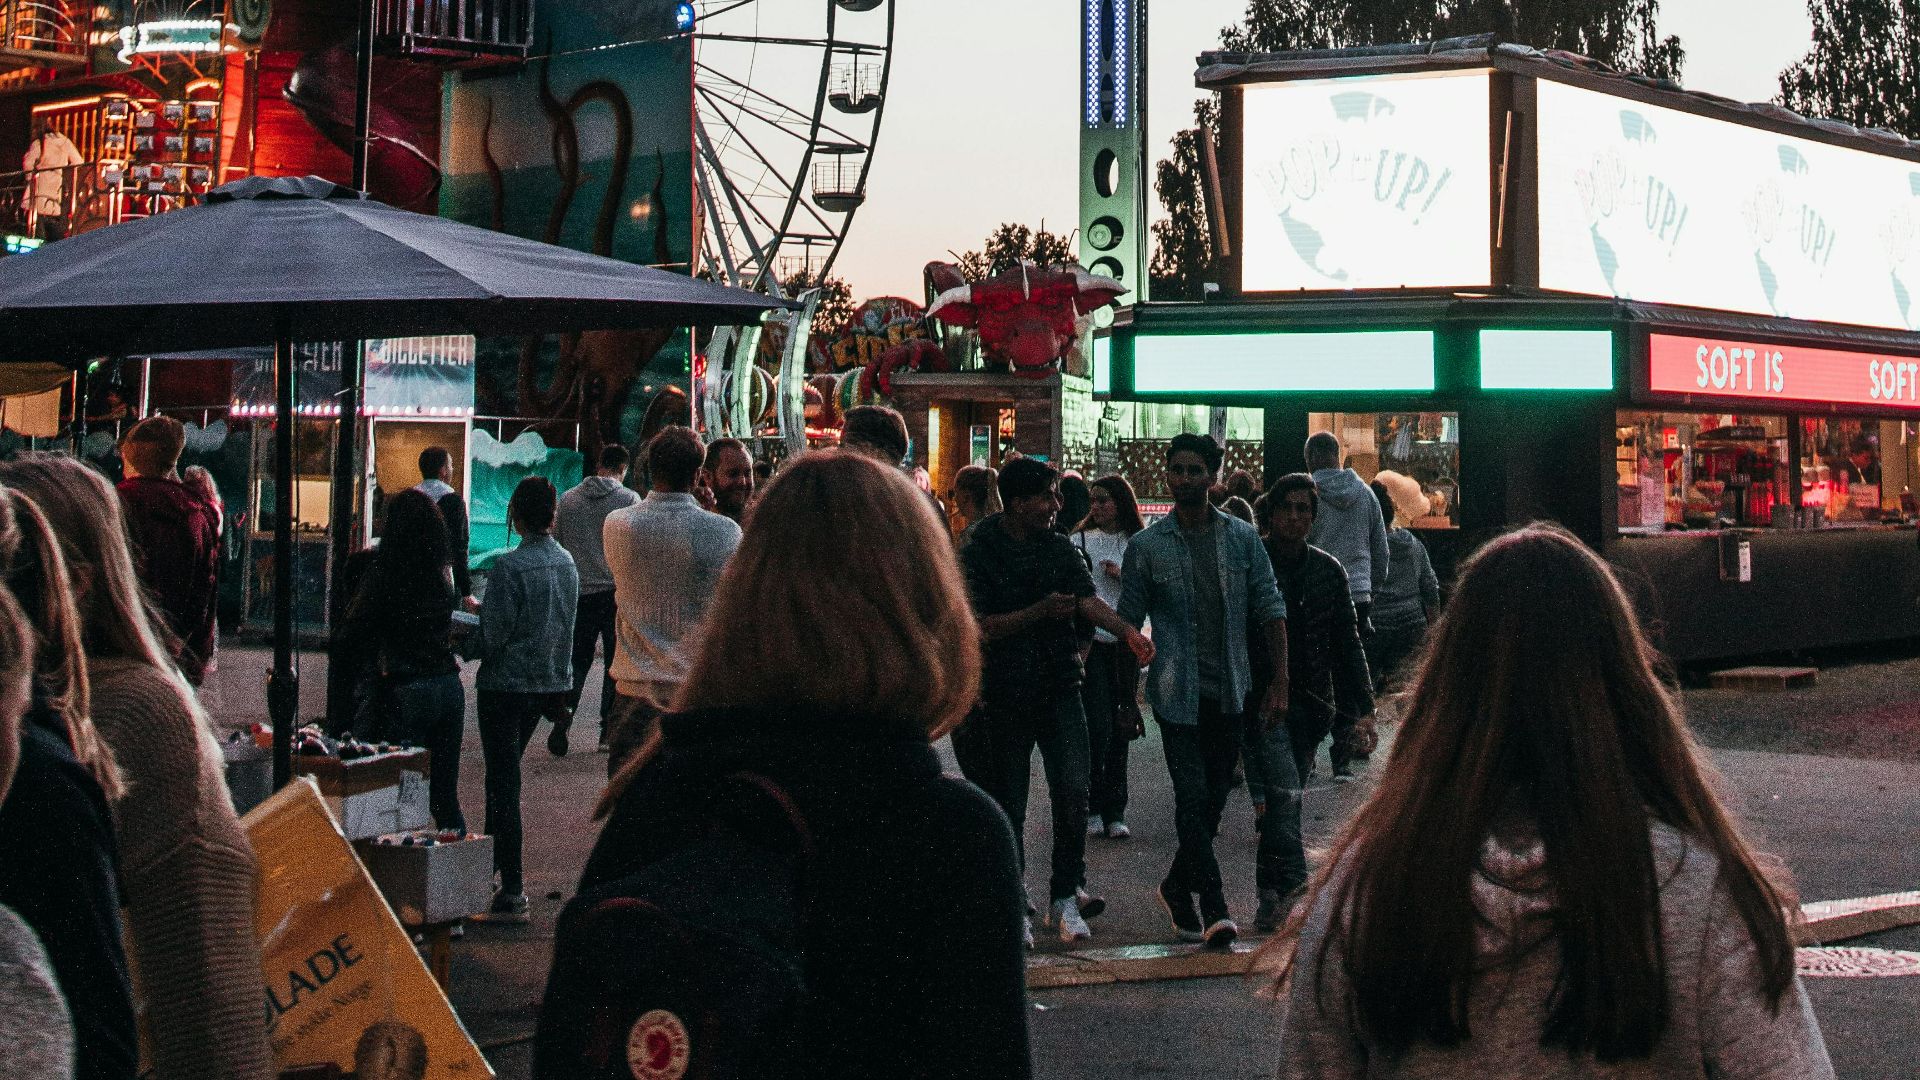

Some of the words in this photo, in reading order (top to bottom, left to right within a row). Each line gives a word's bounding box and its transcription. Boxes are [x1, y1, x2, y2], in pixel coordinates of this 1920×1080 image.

[1374, 148, 1452, 226] UP!
[1646, 175, 1688, 258] UP!
[1801, 204, 1836, 279] UP!
[1696, 344, 1757, 391] SOFT
[1764, 350, 1785, 393] IS
[1868, 359, 1919, 401] SOFT
